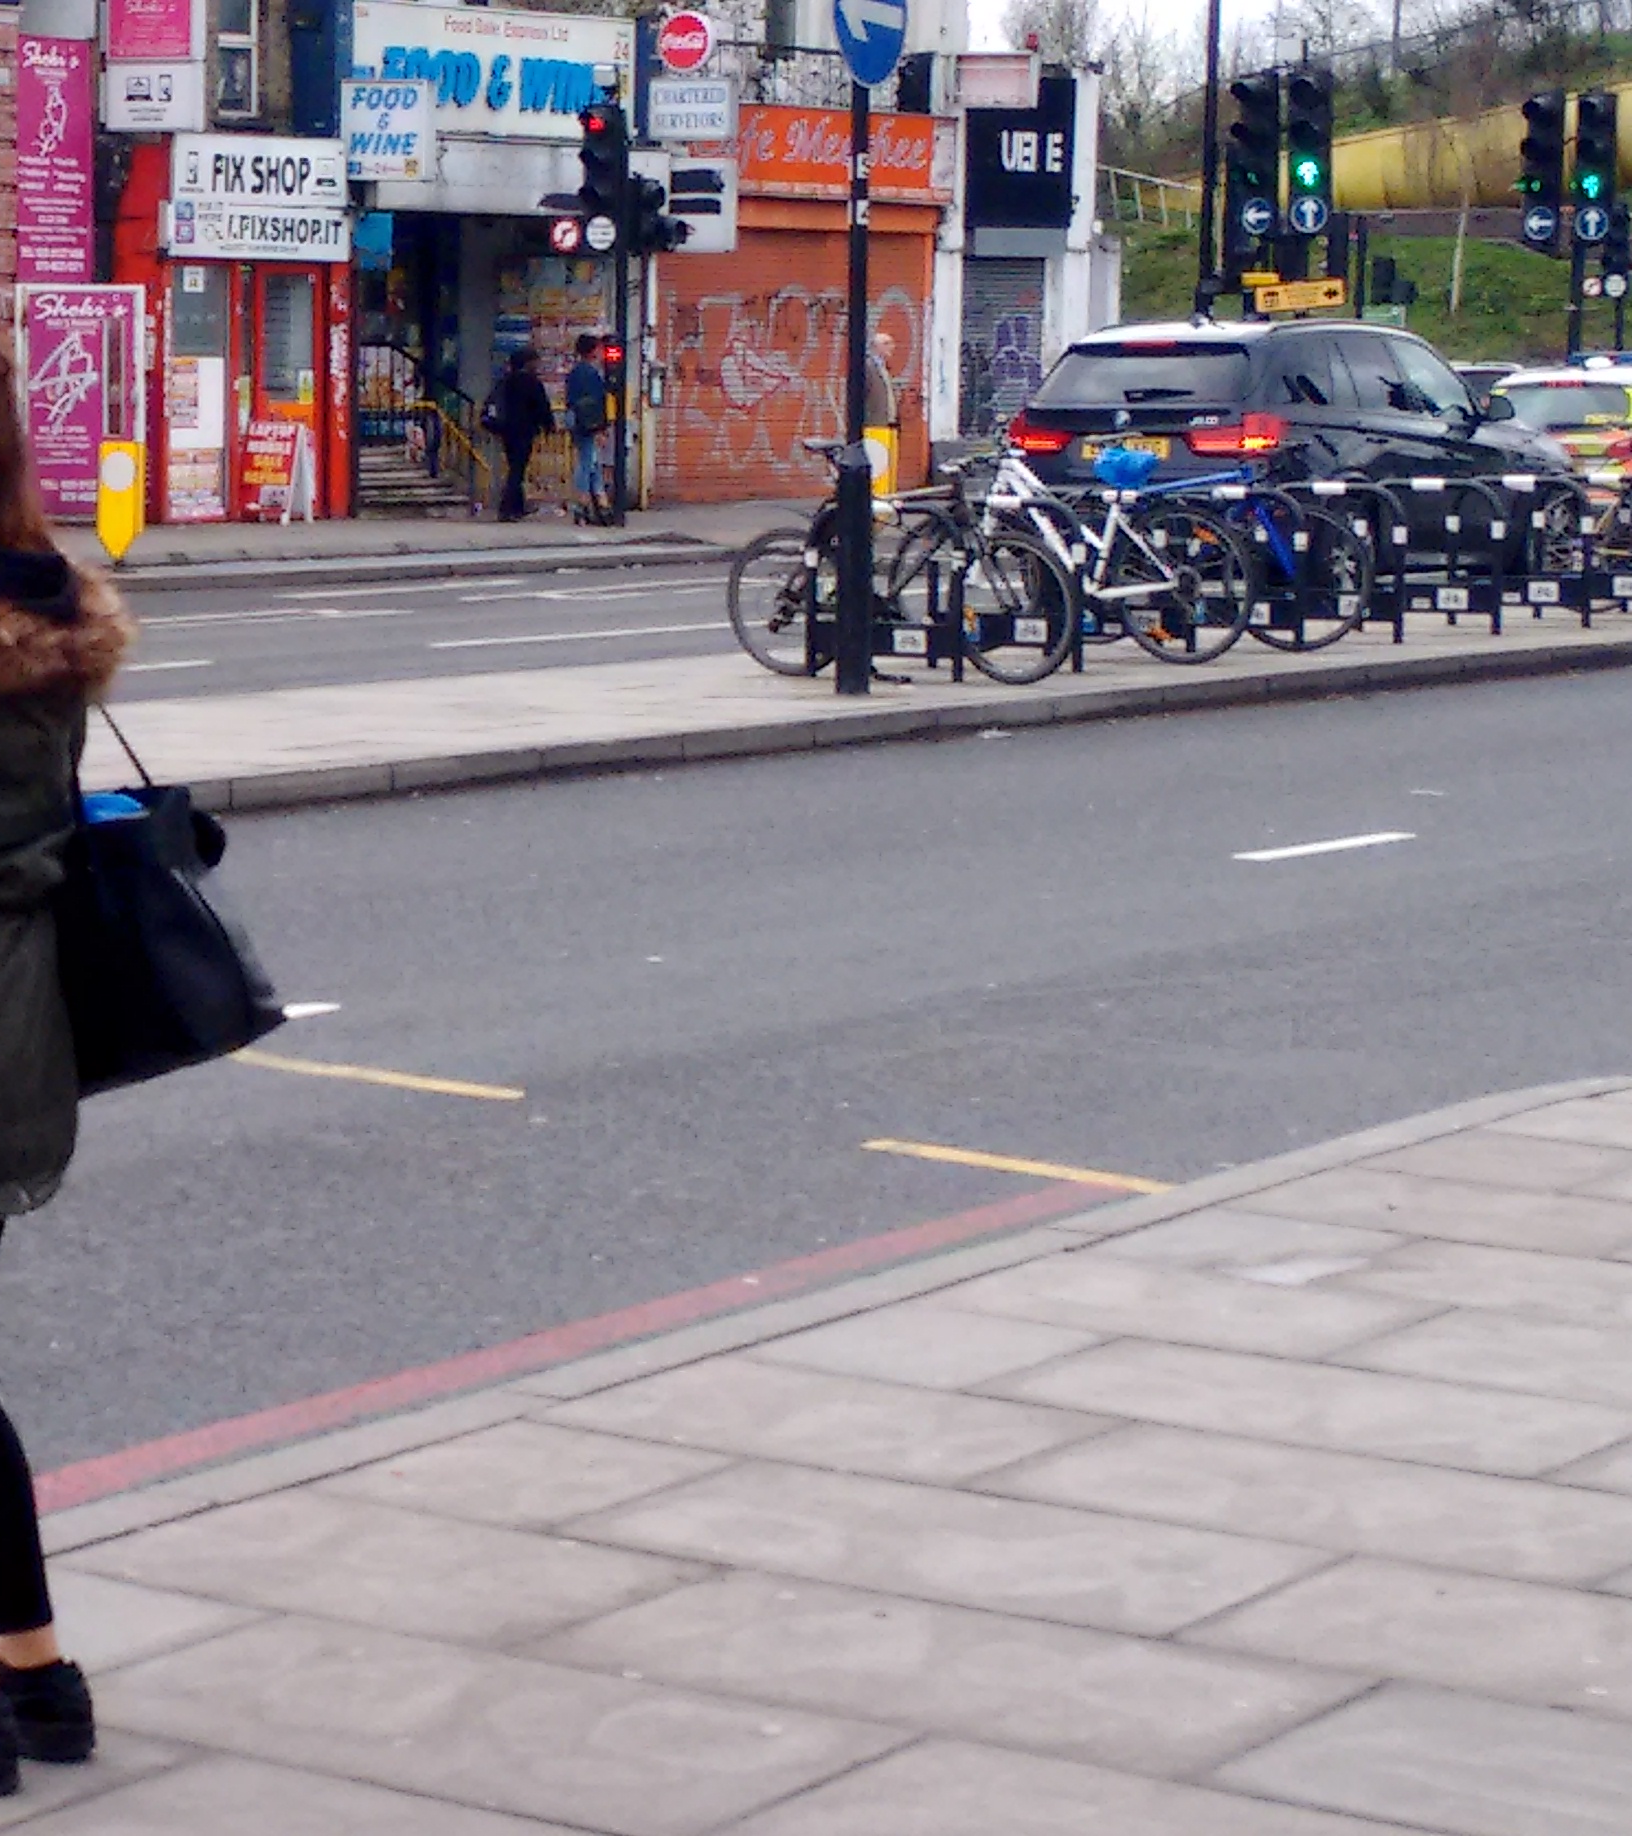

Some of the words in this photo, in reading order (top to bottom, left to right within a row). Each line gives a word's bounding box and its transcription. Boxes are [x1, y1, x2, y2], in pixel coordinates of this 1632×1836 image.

[351, 86, 418, 110] FOOD
[486, 54, 512, 111] &
[519, 57, 606, 114] WIN
[350, 131, 417, 155] WINE
[211, 153, 245, 193] FIX
[250, 156, 311, 196] SHOP
